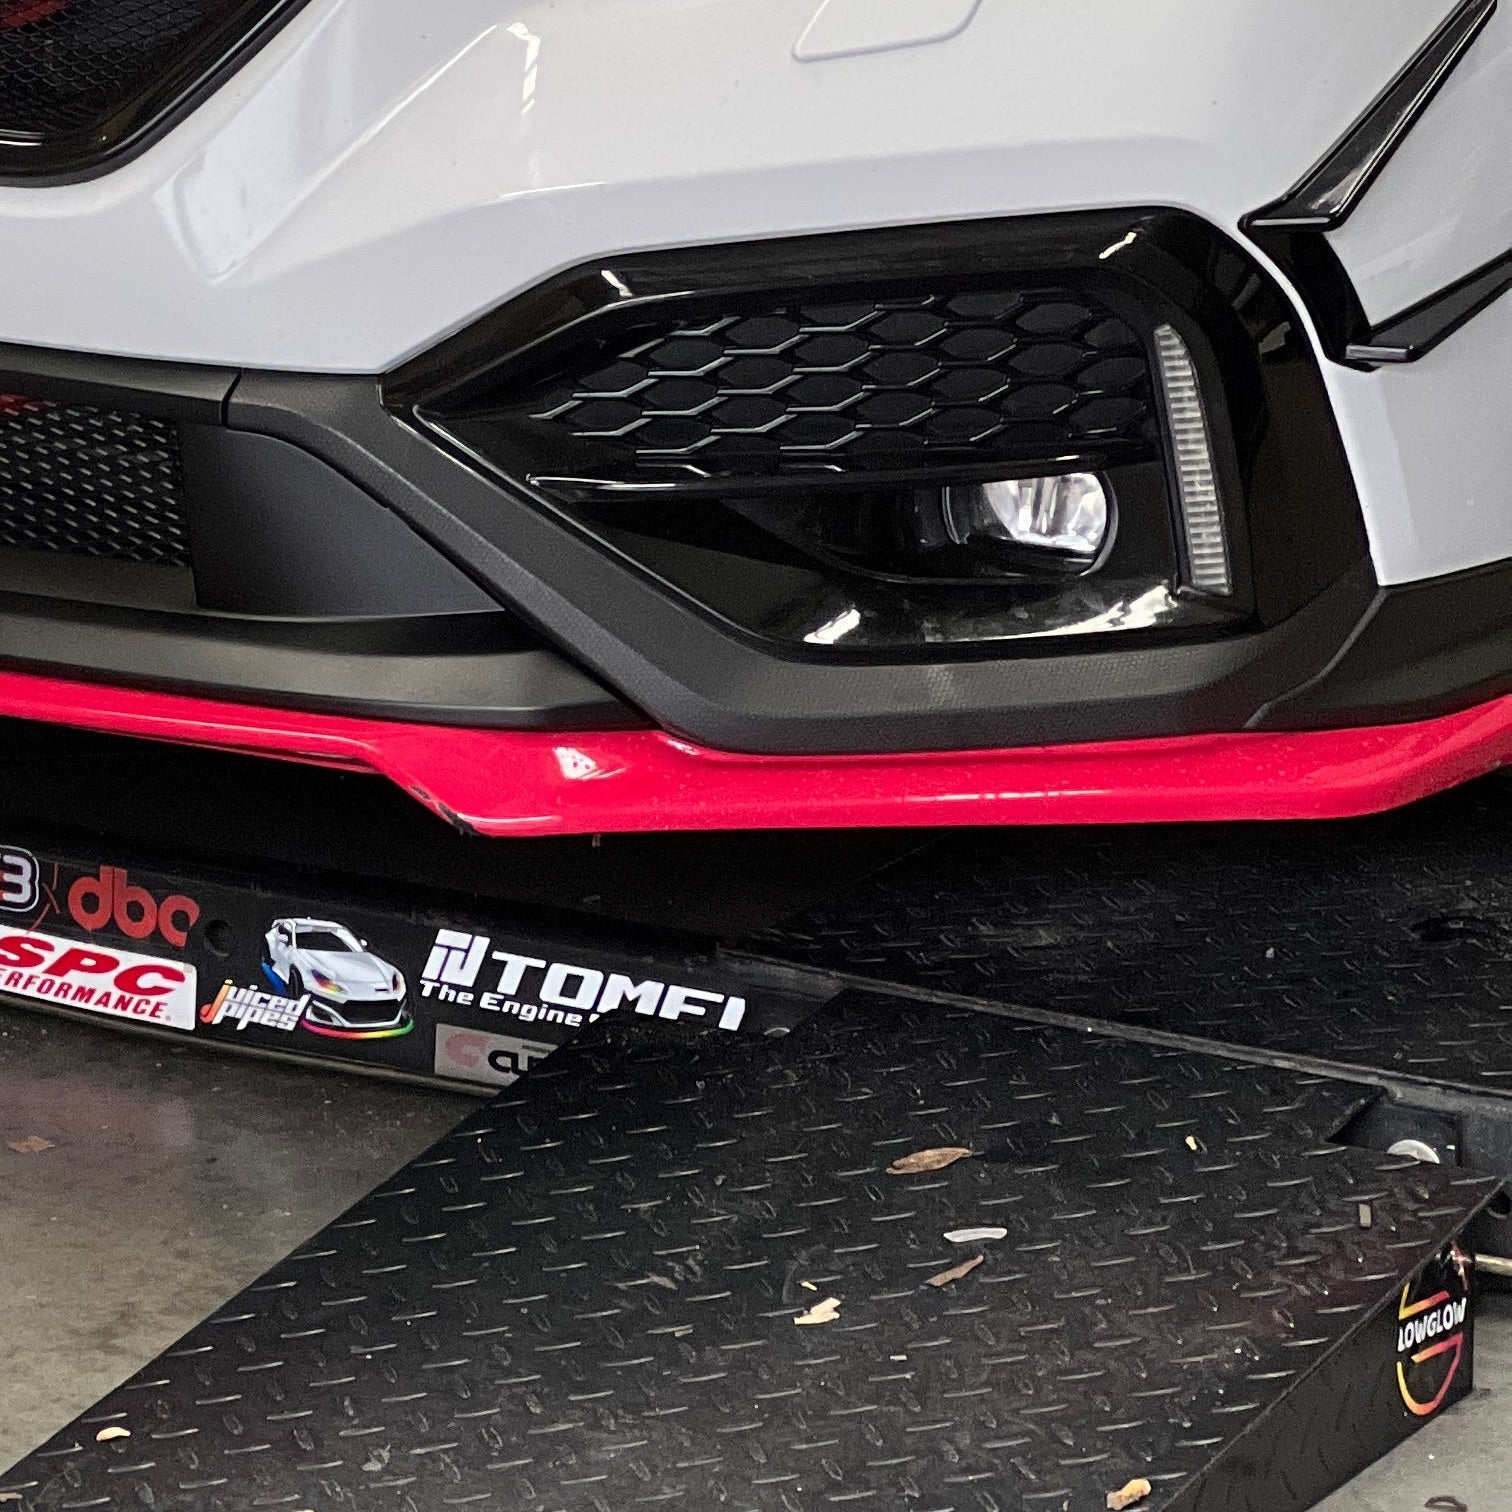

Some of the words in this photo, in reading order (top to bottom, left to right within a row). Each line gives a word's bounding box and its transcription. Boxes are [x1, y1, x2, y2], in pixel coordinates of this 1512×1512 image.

[420, 979, 475, 1006] The
[479, 992, 584, 1028] Engine
[1397, 1297, 1467, 1352] LOWGLOW
